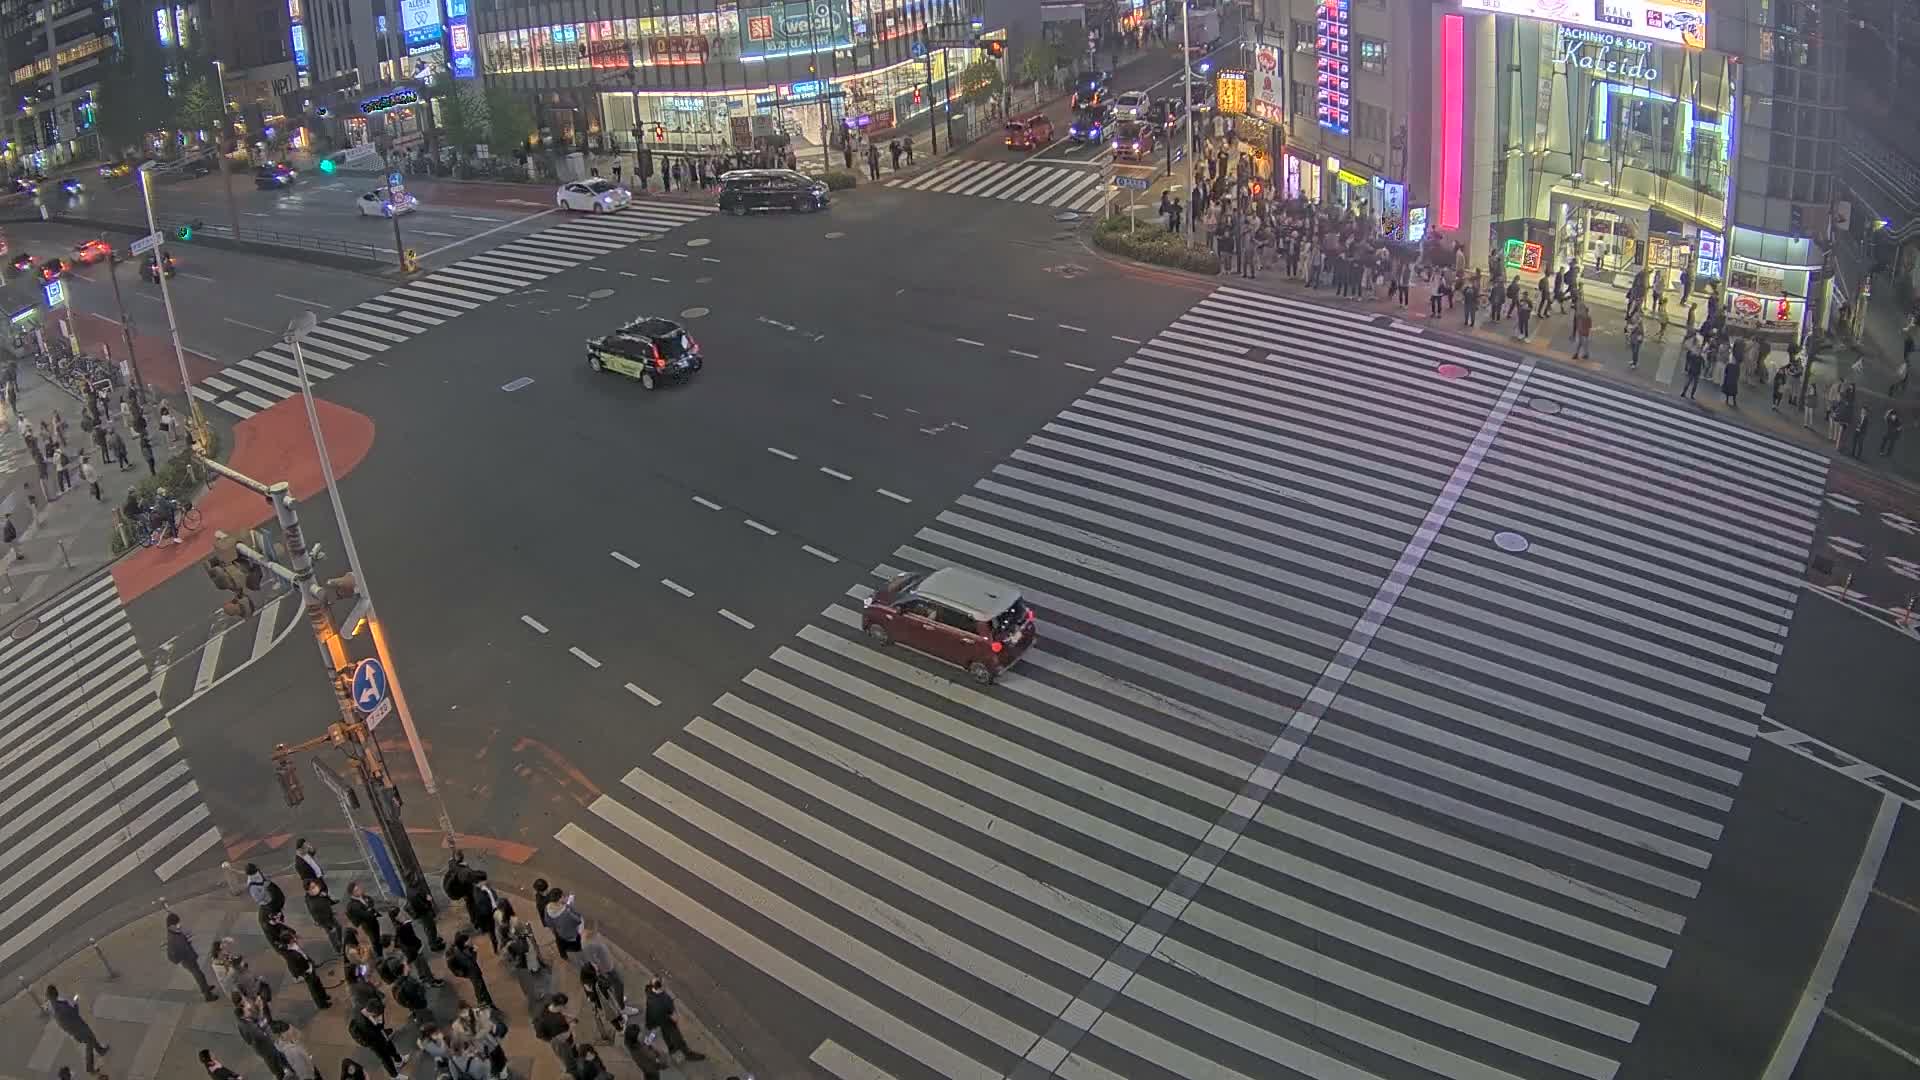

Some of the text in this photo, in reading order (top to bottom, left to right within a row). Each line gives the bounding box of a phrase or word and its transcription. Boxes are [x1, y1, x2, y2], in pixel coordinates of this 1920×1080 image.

[1559, 27, 1653, 52] PACHINKO & SLOT
[1552, 38, 1657, 81] Kaleido
